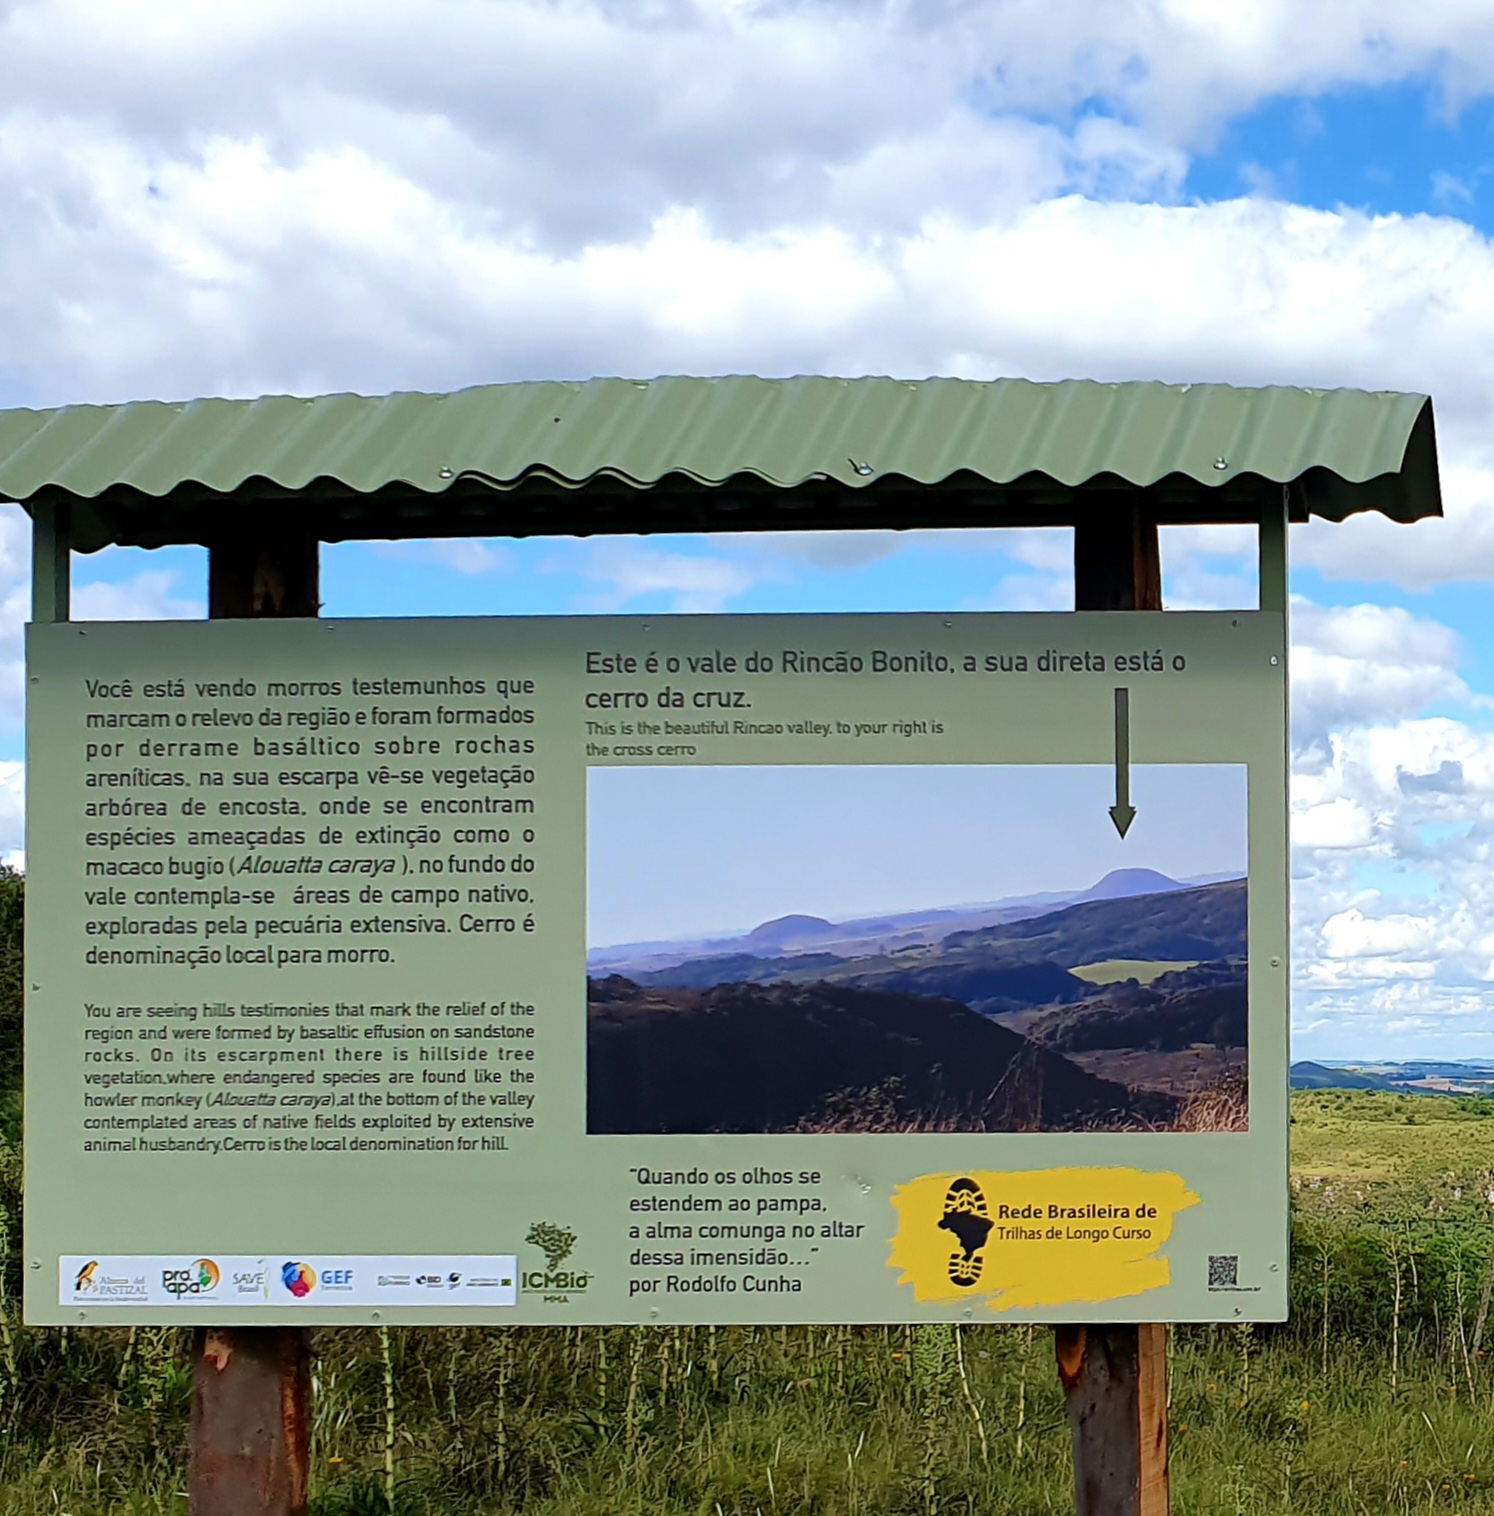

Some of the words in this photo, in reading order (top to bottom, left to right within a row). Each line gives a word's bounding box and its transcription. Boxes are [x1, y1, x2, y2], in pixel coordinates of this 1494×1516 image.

[586, 652, 637, 674] Este
[645, 651, 658, 673] é
[666, 658, 680, 673] o
[687, 650, 737, 673] vale
[745, 651, 773, 672] do
[782, 651, 863, 673] Rincão
[872, 650, 954, 673] Bonito,
[963, 656, 976, 672] a
[984, 656, 1027, 672] sua
[1037, 650, 1105, 672] direta
[1114, 649, 1163, 671] está
[1172, 655, 1185, 671] o
[86, 679, 133, 698] Você
[143, 679, 184, 697] está
[195, 678, 256, 697] vendo
[267, 682, 342, 696] morros
[352, 676, 486, 695] testemunhos
[496, 680, 534, 699] que
[585, 692, 648, 708] cerro
[657, 686, 684, 708] da
[693, 692, 751, 708] cruz.
[87, 714, 170, 728] marcam
[175, 714, 187, 727] o
[192, 708, 254, 727] relevo
[258, 708, 282, 726] da
[287, 707, 350, 731] região
[355, 712, 367, 725] e
[371, 706, 431, 725] foram
[437, 705, 534, 724] formados
[585, 721, 617, 735] This
[620, 721, 634, 735] is
[637, 721, 661, 735] the
[664, 721, 729, 735] beautiful
[733, 720, 783, 734] Rincao
[836, 722, 851, 734] to
[854, 724, 888, 737] your
[892, 720, 927, 737] right
[931, 720, 944, 733] is
[87, 744, 124, 762] por
[139, 738, 239, 757] derrame
[254, 736, 360, 756] basáltico
[374, 736, 440, 754] sobre
[456, 735, 534, 754] rochas
[586, 742, 609, 756] the
[613, 746, 653, 756] cross
[657, 746, 696, 756] cerro
[200, 772, 224, 786] na
[232, 772, 269, 786] sua
[278, 771, 359, 790] escarpa
[367, 766, 424, 784] vê-se
[432, 765, 534, 789] vegetação
[85, 797, 167, 816] arbórea
[181, 797, 206, 815] de
[319, 796, 371, 814] onde
[383, 800, 408, 814] se
[421, 796, 534, 814] encontram
[86, 827, 175, 851] espécies
[188, 826, 305, 850] ameaçadas
[319, 826, 343, 844] de
[355, 825, 441, 849] extinção
[453, 829, 509, 843] como
[523, 829, 534, 842] o
[86, 862, 164, 875] macaco
[169, 856, 224, 880] bugio
[328, 859, 395, 878] caraya
[419, 860, 443, 873] no
[448, 854, 505, 873] fundo
[511, 854, 534, 872] do
[85, 887, 126, 905] vale
[134, 886, 275, 909] contempla-se
[293, 885, 350, 904] áreas
[359, 885, 383, 903] de
[391, 889, 459, 908] campo
[86, 916, 198, 940] exploradas
[205, 915, 247, 939] pela
[254, 914, 342, 939] pecuária
[350, 914, 451, 933] extensiva.
[459, 914, 515, 932] Cerro
[523, 913, 535, 932] é
[86, 945, 222, 969] denominação
[226, 945, 274, 963] local
[278, 950, 322, 968] para
[327, 949, 395, 963] morro.
[84, 1004, 111, 1017] You
[116, 1007, 142, 1018] are
[146, 1003, 197, 1021] seeing
[203, 1003, 235, 1017] hills
[241, 1003, 330, 1017] testimonies
[335, 1003, 365, 1016] that
[370, 1002, 411, 1016] mark
[416, 1002, 440, 1016] the
[446, 1002, 486, 1016] relief
[490, 1002, 506, 1016] of
[510, 1001, 535, 1015] the
[85, 1026, 133, 1043] region
[138, 1025, 167, 1039] and
[172, 1029, 211, 1039] were
[216, 1025, 272, 1040] formed
[277, 1025, 295, 1043] by
[300, 1025, 359, 1039] basaltic
[364, 1024, 425, 1039] effusion
[430, 1028, 449, 1038] on
[454, 1024, 534, 1038] sandstone
[84, 1115, 188, 1133] contemplated
[193, 1118, 237, 1129] areas
[243, 1114, 258, 1129] of
[263, 1114, 308, 1129] native
[314, 1114, 356, 1129] fields
[362, 1113, 431, 1132] exploited
[437, 1114, 456, 1132] by
[462, 1113, 534, 1128] extensive
[714, 1172, 736, 1184] os
[742, 1167, 793, 1184] olhos
[798, 1172, 821, 1184] se
[630, 1194, 722, 1211] estendem
[728, 1199, 750, 1211] ao
[756, 1198, 826, 1216] pampa,
[999, 1204, 1043, 1219] Rede
[1048, 1204, 1130, 1219] Brasileira
[1135, 1204, 1157, 1218] de
[629, 1226, 639, 1238] a
[645, 1221, 692, 1238] alma
[698, 1226, 785, 1243] comunga
[792, 1225, 815, 1238] no
[820, 1221, 865, 1238] altar
[997, 1226, 1042, 1240] Trilhas
[1046, 1226, 1062, 1239] de
[1066, 1226, 1109, 1243] Longo
[1112, 1226, 1151, 1239] Curso
[630, 1248, 684, 1265] dessa
[232, 1272, 264, 1285] SAVE
[321, 1270, 353, 1284] GEF
[522, 1272, 594, 1289] ICMBio
[630, 1280, 661, 1297] por
[667, 1275, 736, 1292] Rodolfo
[743, 1275, 801, 1292] Cunha
